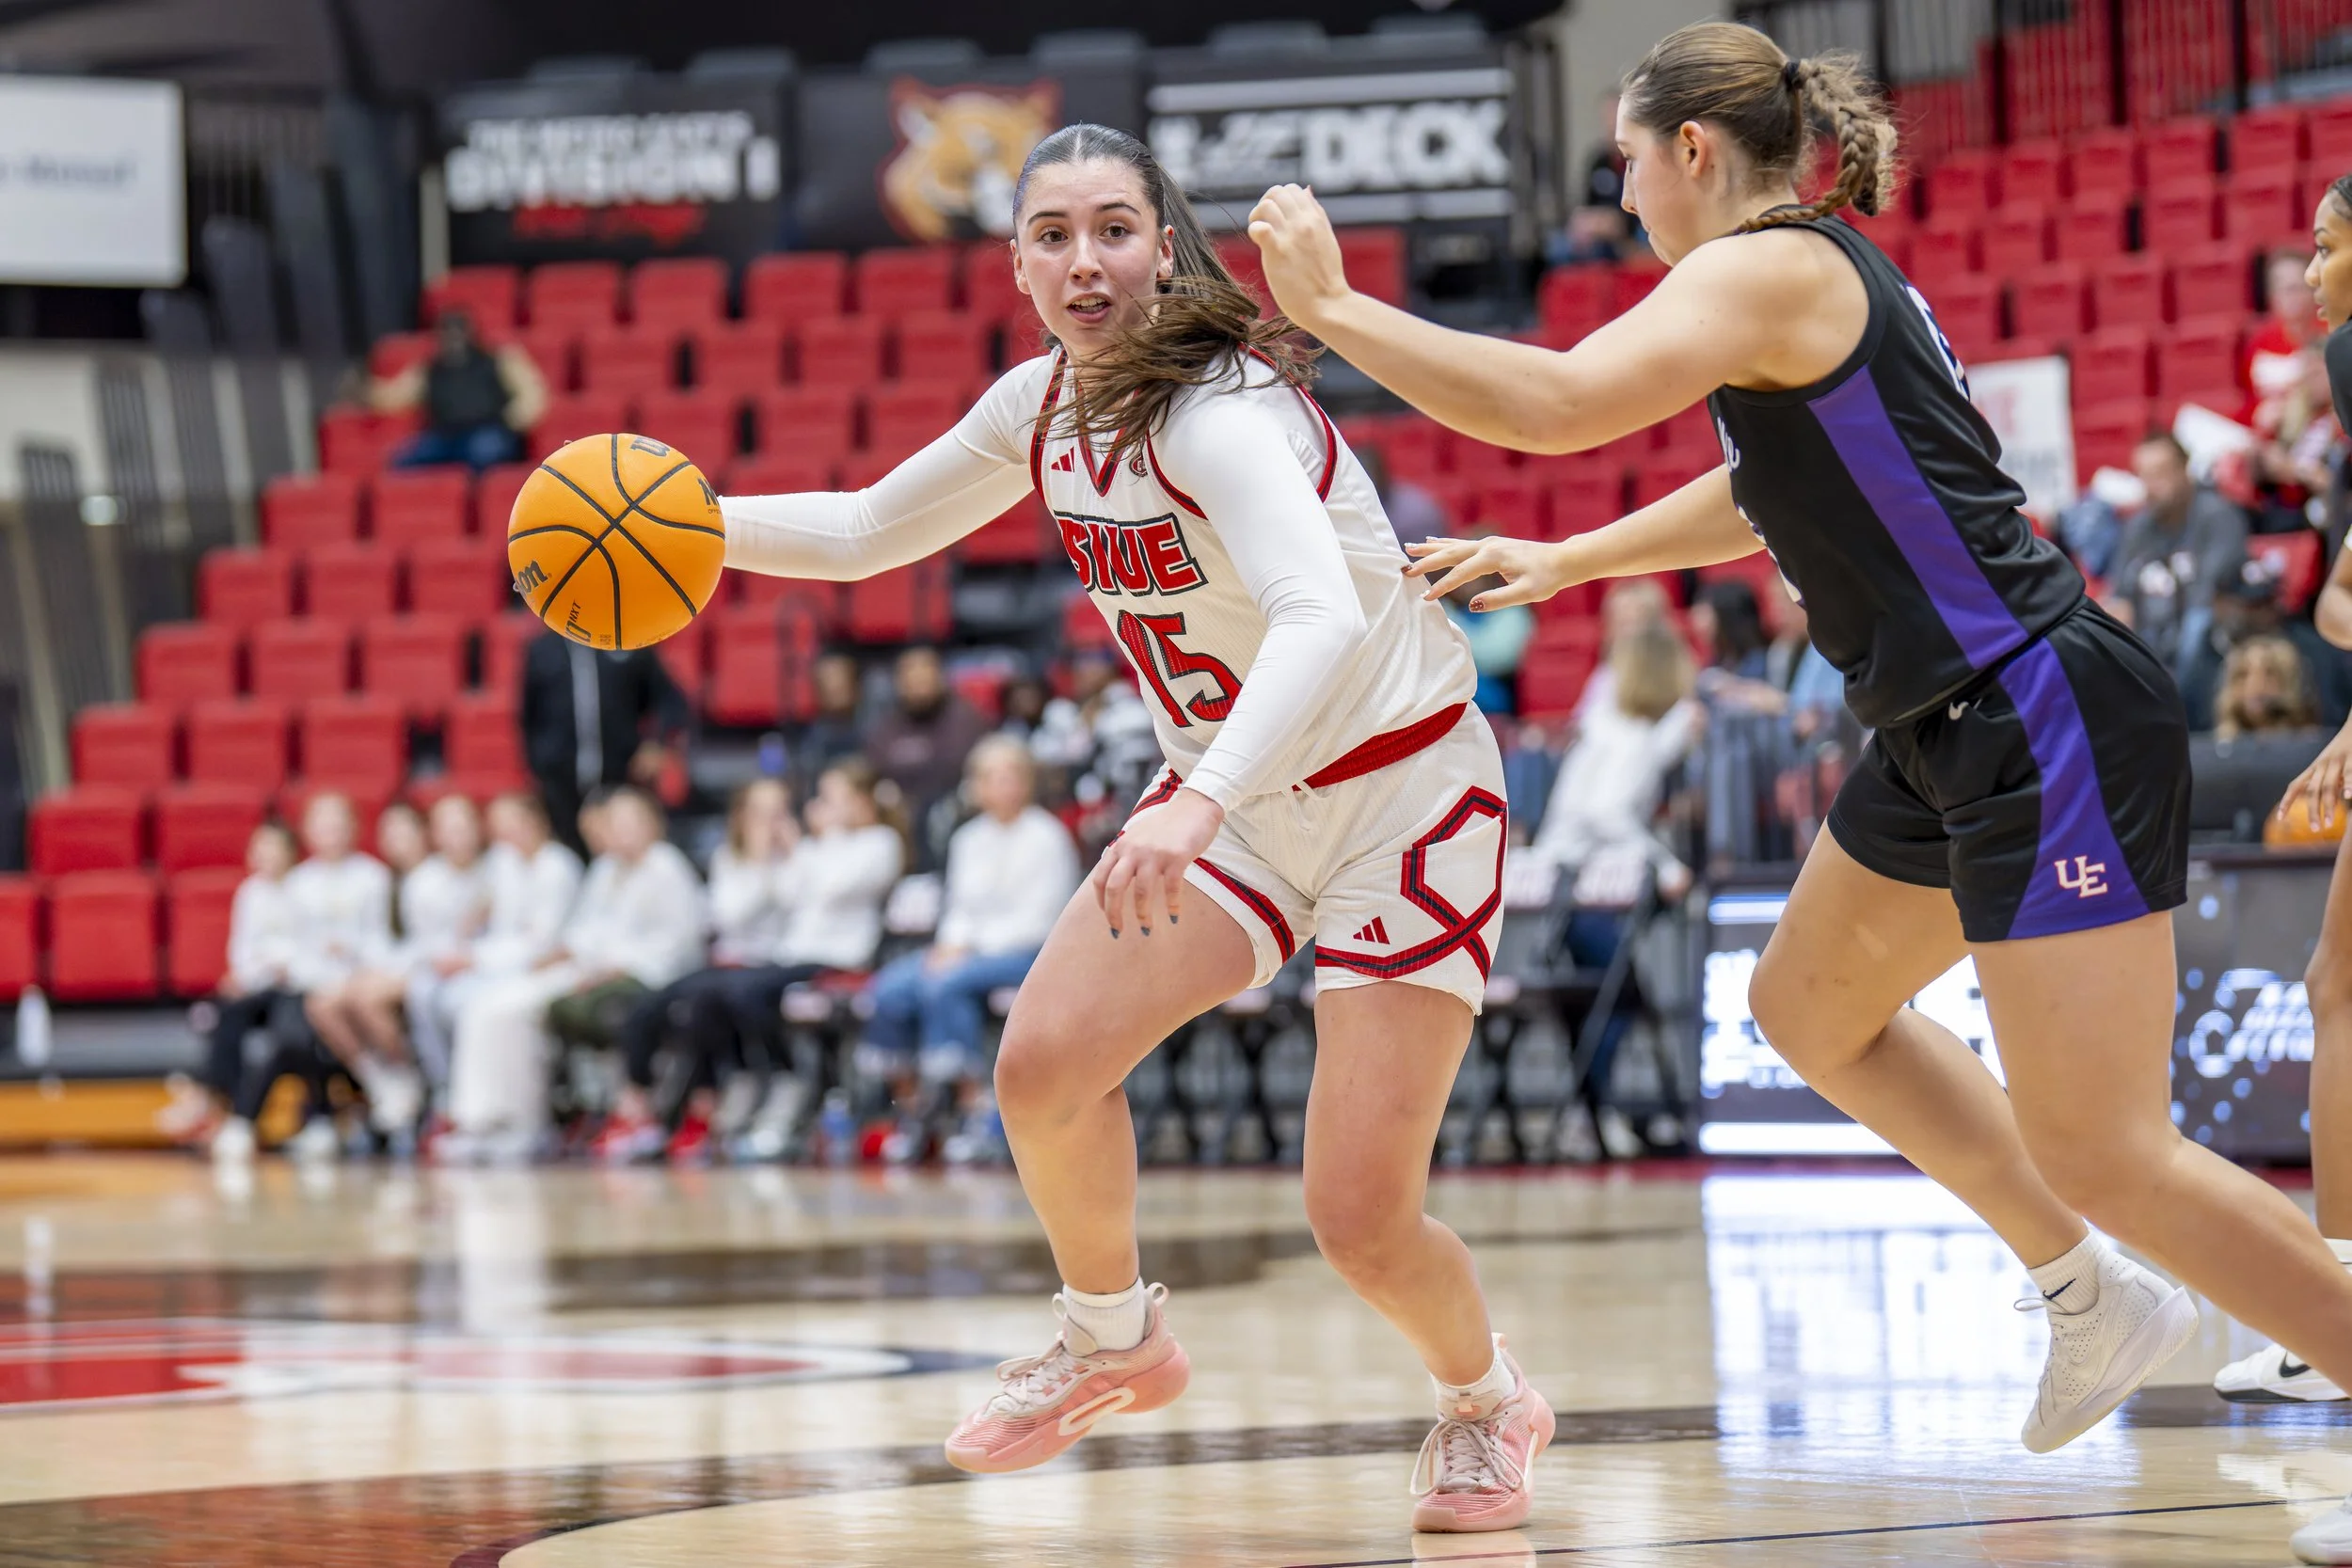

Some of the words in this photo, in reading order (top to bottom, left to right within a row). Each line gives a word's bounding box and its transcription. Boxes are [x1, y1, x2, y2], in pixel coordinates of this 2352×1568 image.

[1054, 512, 1209, 596] SIUE
[1117, 610, 1244, 728] 15
[2054, 855, 2108, 898] UE
